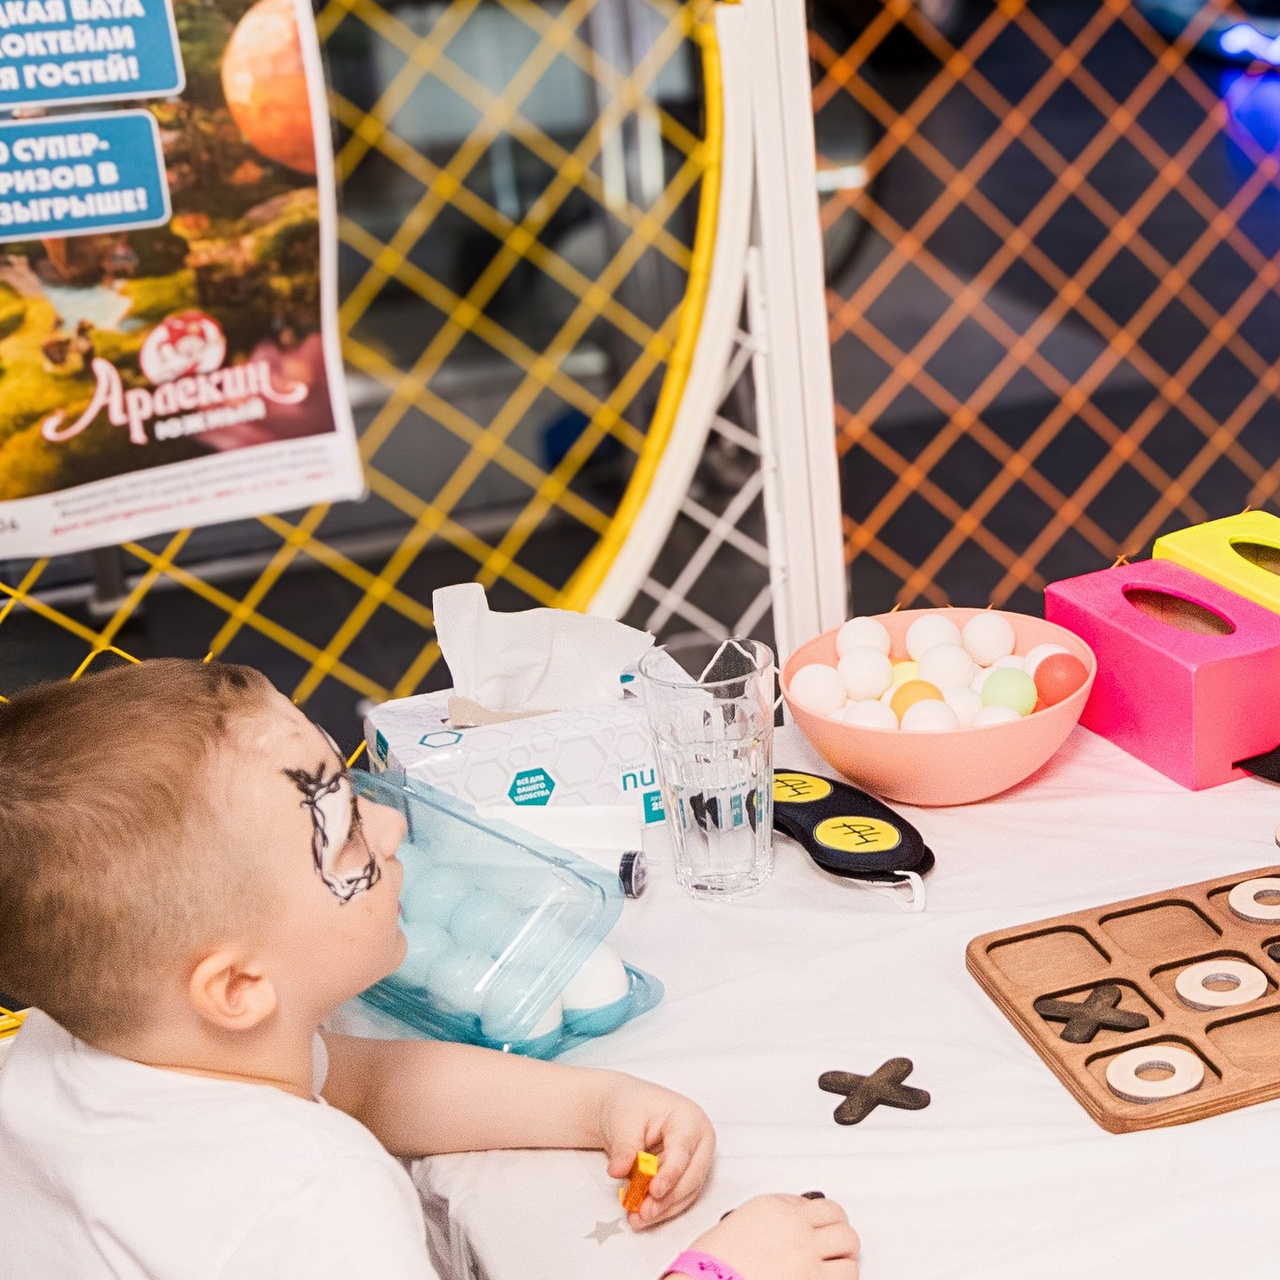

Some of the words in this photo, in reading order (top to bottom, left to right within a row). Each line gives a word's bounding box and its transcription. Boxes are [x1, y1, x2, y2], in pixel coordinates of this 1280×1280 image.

[22, 53, 140, 89] ГОСТЕЙ!
[12, 132, 110, 163] СУПЕР-
[42, 357, 309, 445] Арлекин
